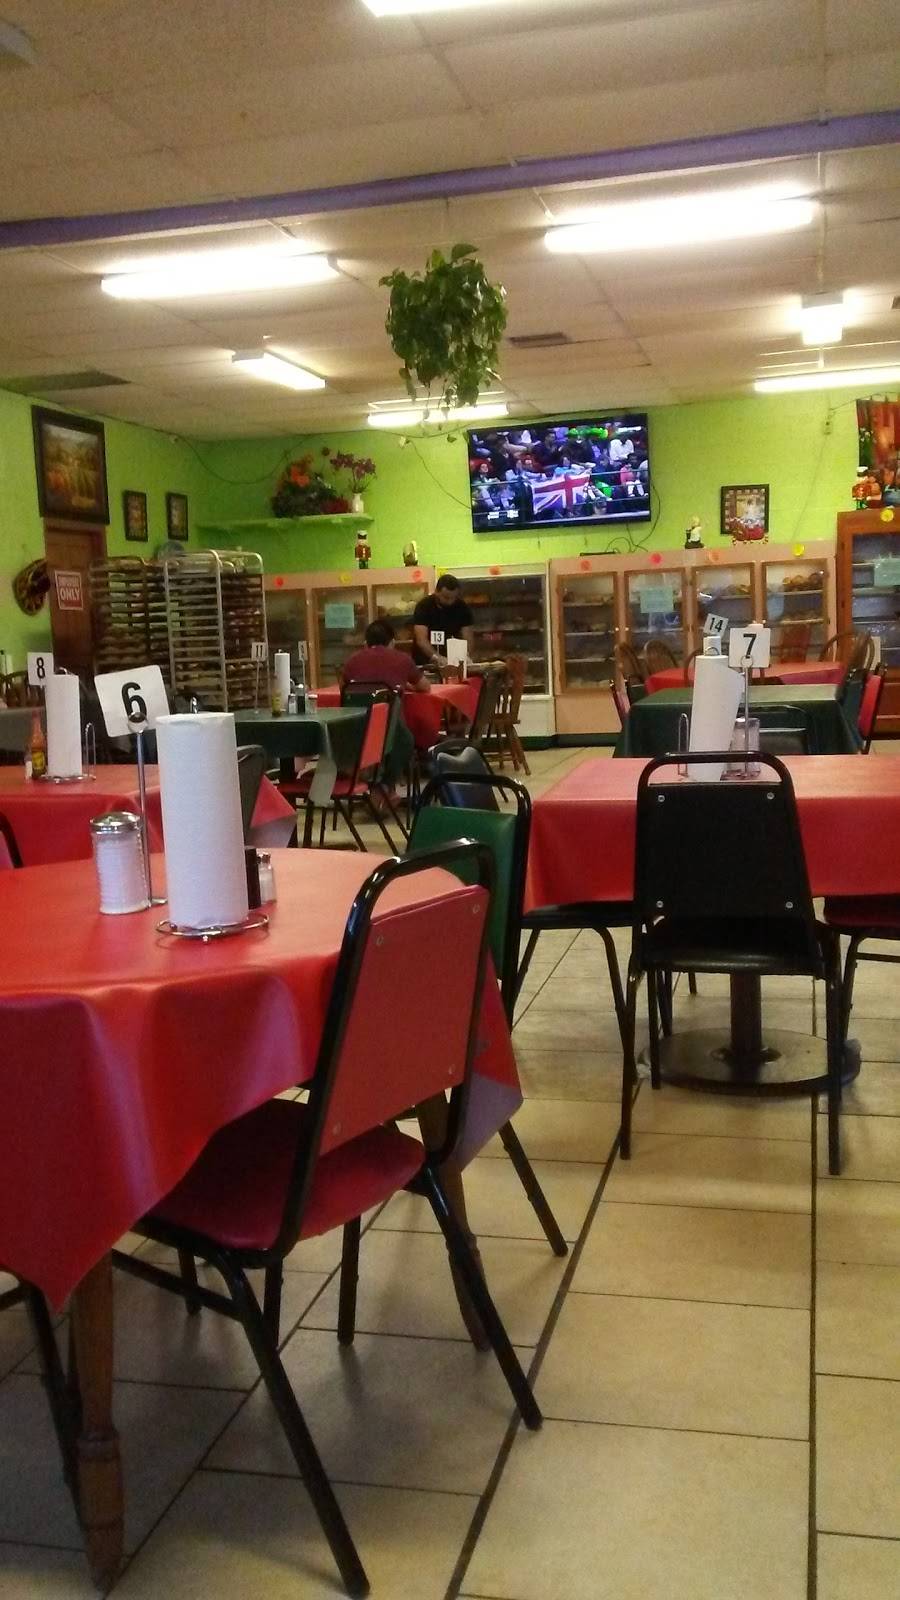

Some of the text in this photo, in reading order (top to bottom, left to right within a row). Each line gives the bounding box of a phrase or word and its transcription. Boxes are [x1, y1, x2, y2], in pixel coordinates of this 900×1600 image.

[61, 586, 80, 601] ONLY
[710, 616, 724, 632] 14
[433, 633, 442, 643] 13
[743, 633, 757, 659] 7
[256, 645, 263, 658] 11
[36, 657, 46, 679] 8
[120, 682, 147, 718] 6
